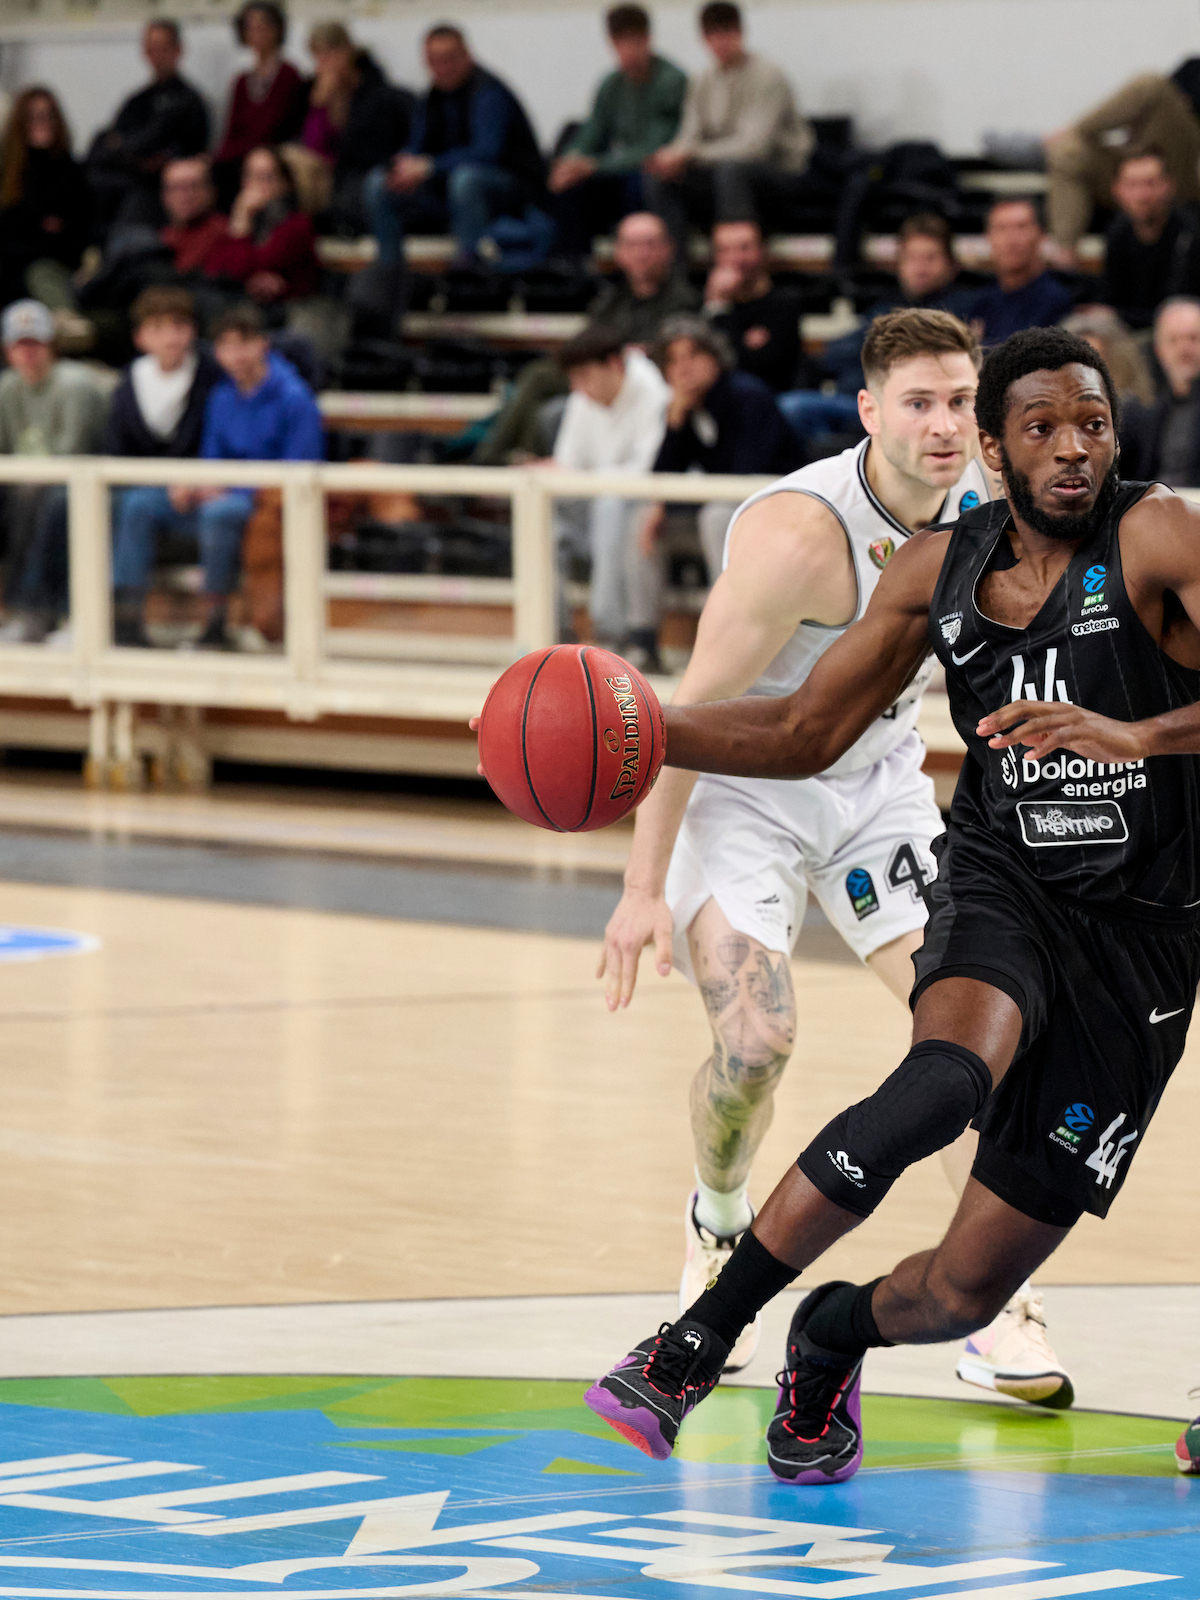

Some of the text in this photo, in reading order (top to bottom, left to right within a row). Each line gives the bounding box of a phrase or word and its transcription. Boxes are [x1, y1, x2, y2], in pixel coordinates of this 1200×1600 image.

[1080, 604, 1109, 617] EuroCup
[1071, 617, 1120, 637] oneteam
[605, 674, 641, 801] SPALDING
[1061, 773, 1147, 798] energia
[1030, 813, 1114, 836] TRENTINO
[884, 838, 935, 904] 4
[1048, 1131, 1079, 1155] EuroCup
[1054, 1125, 1082, 1144] BKT
[1085, 1112, 1138, 1190] 44
